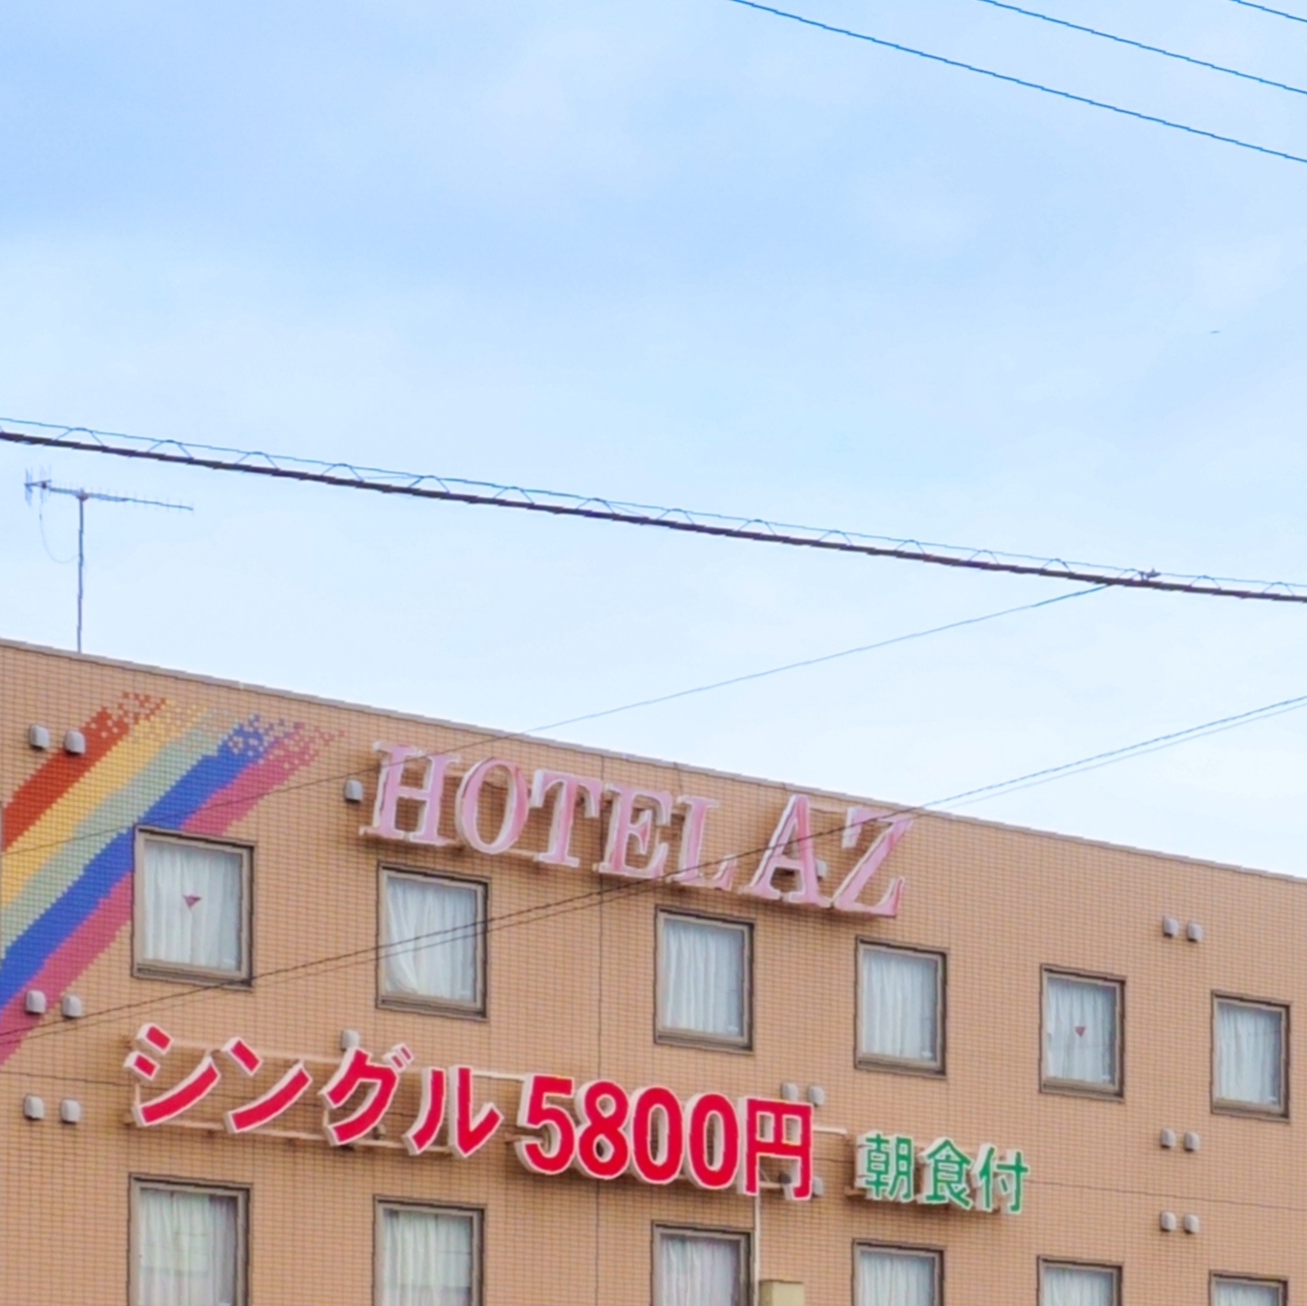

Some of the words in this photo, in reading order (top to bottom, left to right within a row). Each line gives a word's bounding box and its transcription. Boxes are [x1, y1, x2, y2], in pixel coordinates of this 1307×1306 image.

[359, 741, 739, 892] HOTEL
[739, 793, 914, 917] AZ
[123, 1022, 503, 1159] シングル
[515, 1072, 817, 1200] 5800円
[855, 1130, 1031, 1214] 朝食付
